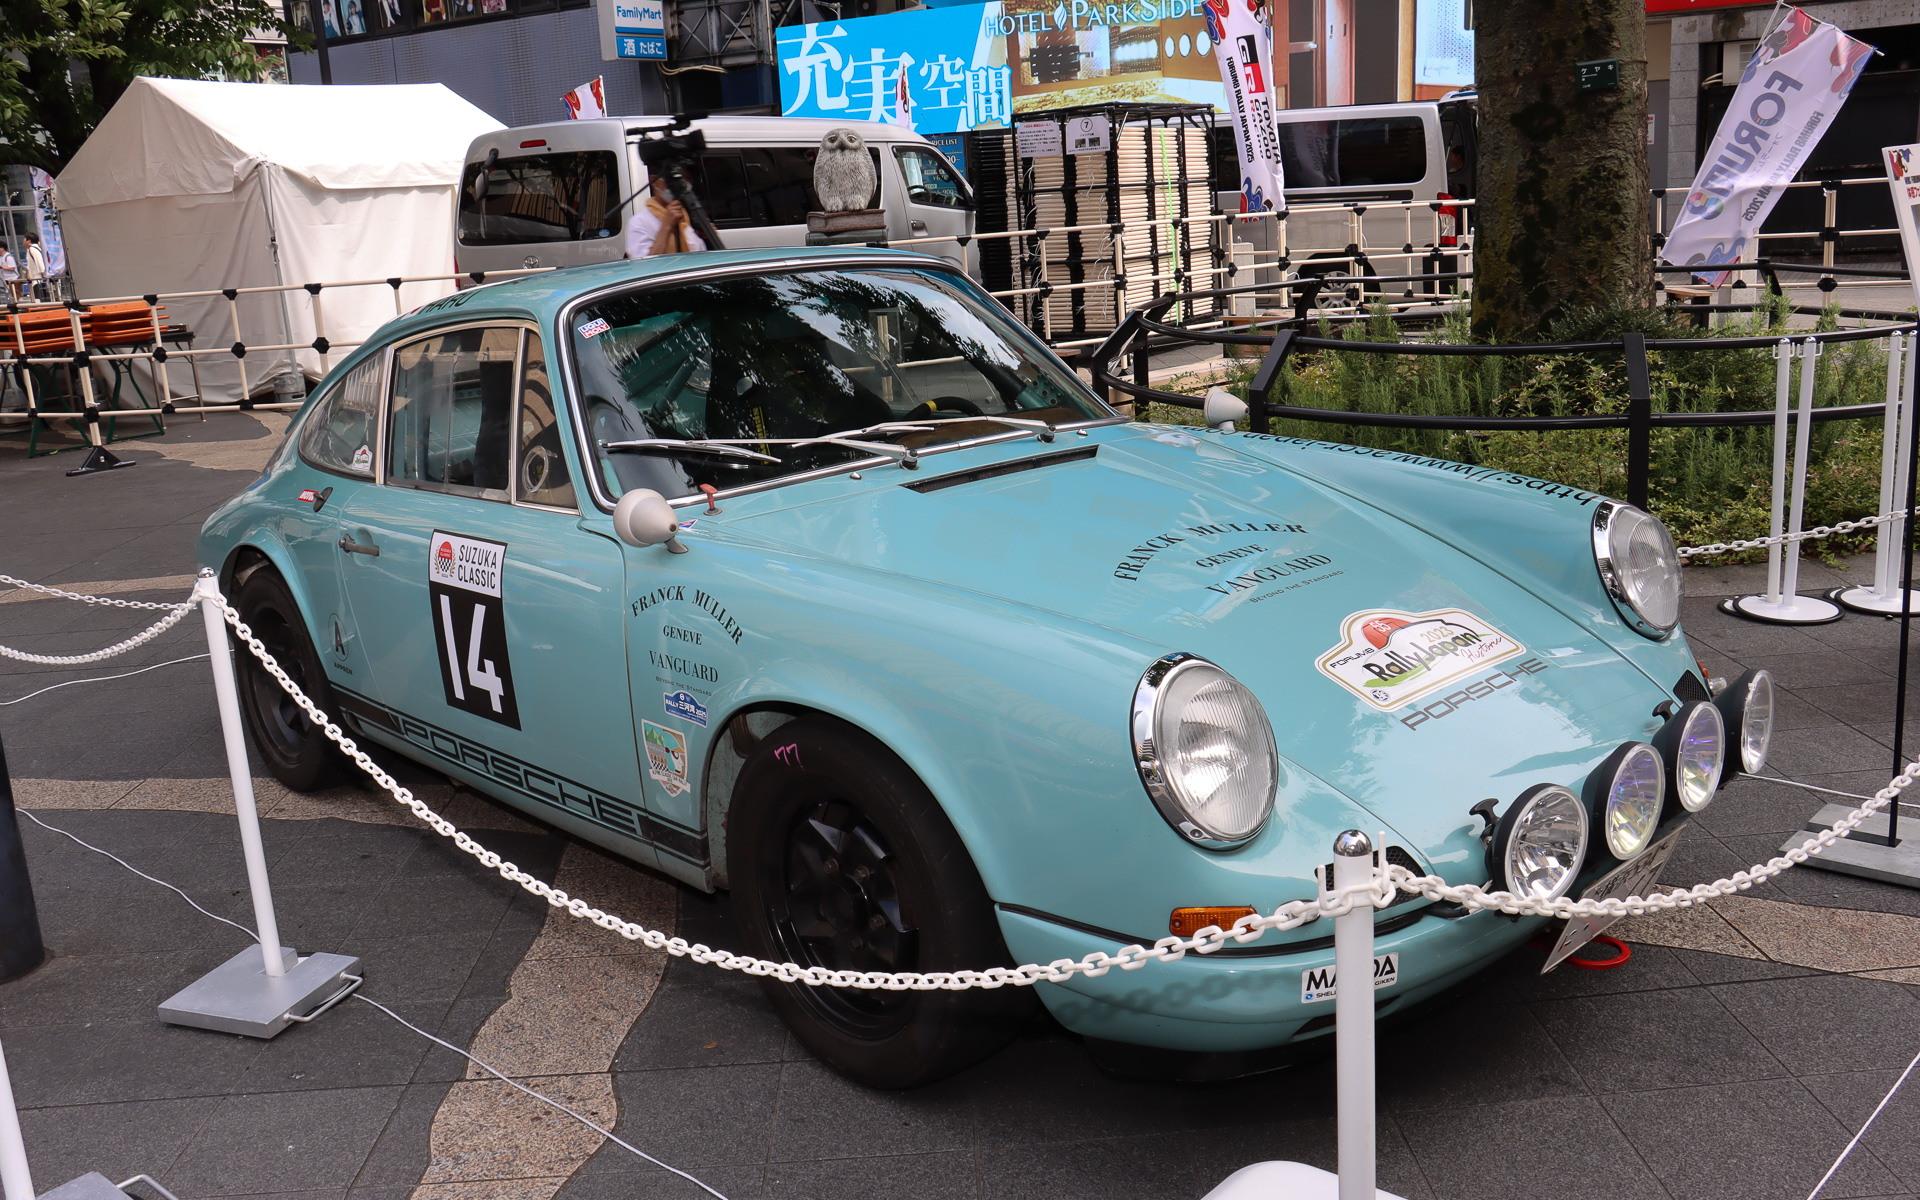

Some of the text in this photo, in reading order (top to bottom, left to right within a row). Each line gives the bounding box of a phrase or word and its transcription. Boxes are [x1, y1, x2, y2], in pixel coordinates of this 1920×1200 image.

[616, 5, 662, 21] FamilyMart
[985, 13, 1052, 37] HOTEL
[624, 39, 663, 56] 酒 たばこ
[776, 23, 1012, 131] 充実空間
[1226, 56, 1255, 163] FORUM8 RALLY JAPAN 2025
[1254, 99, 1271, 159] GAZOO
[1261, 96, 1282, 165] TOYOTA
[459, 544, 497, 569] SUZUKA
[1113, 523, 1310, 582] FRANCK MULLER
[1195, 543, 1269, 568] GENEVE
[457, 564, 496, 589] CLASSIC
[1204, 553, 1332, 596] VANGUARD
[631, 585, 743, 645] FRANCK MULLER
[663, 624, 703, 646] GENEVE
[1420, 626, 1455, 643] 2023
[439, 594, 505, 714] 14
[648, 650, 719, 683] VANGUARD
[1329, 647, 1375, 669] FORUM8
[1400, 657, 1549, 731] PORSCHE
[774, 743, 803, 769] 77
[402, 718, 638, 835] PORSCHE
